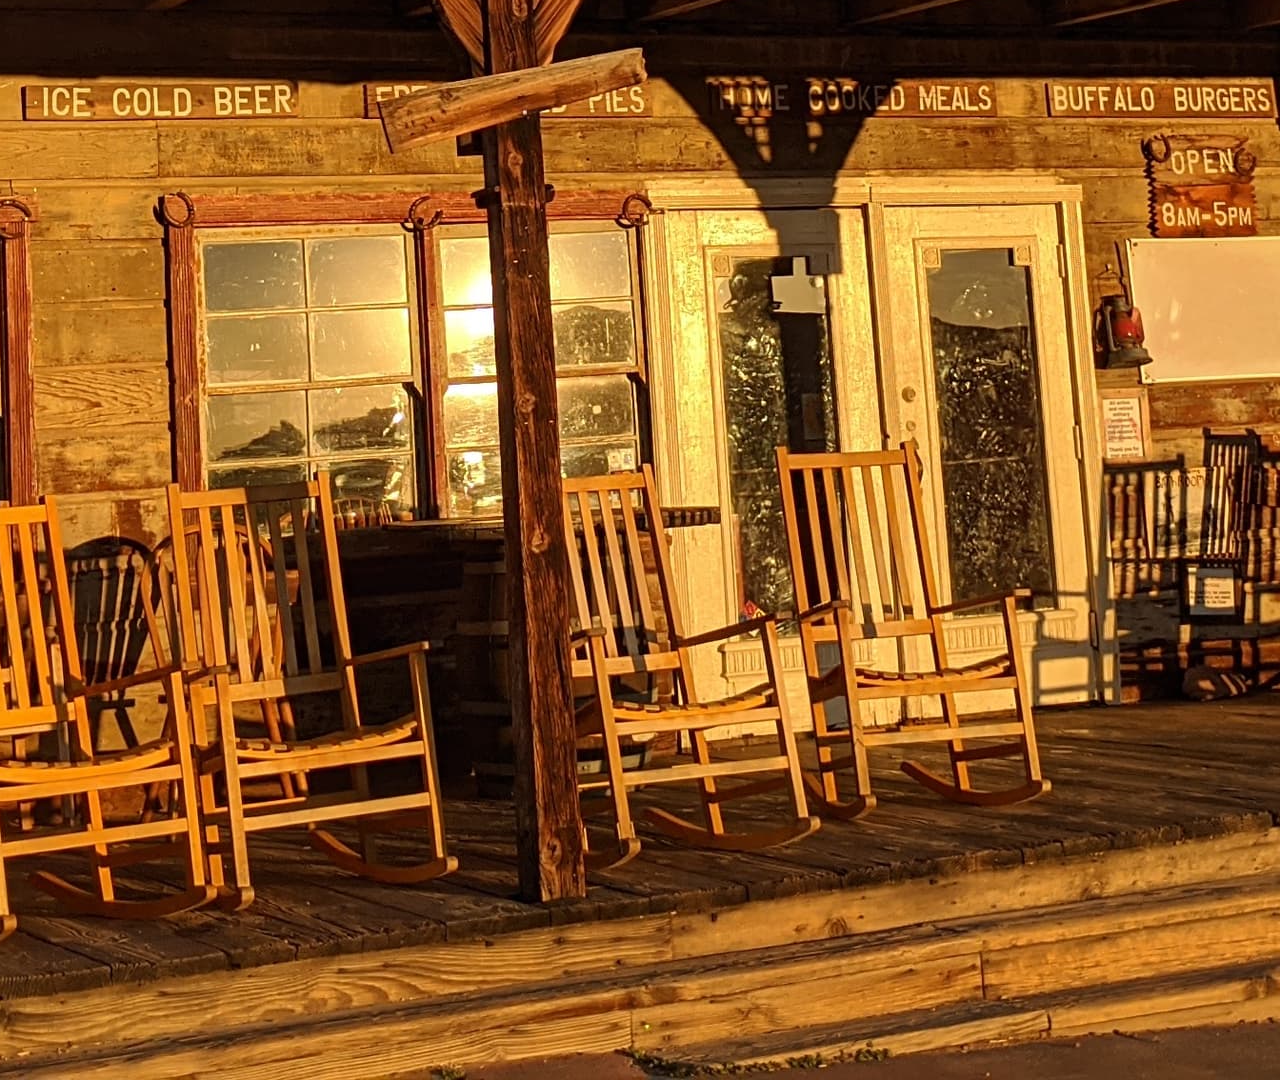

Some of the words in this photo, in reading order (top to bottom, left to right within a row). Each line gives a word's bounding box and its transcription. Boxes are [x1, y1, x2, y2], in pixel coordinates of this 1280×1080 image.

[40, 85, 93, 117] ICE
[111, 86, 193, 117] COLD
[213, 84, 293, 117] BEER
[588, 86, 646, 114] PIES
[719, 83, 792, 112] HOME
[808, 84, 906, 111] COOKED
[919, 84, 993, 112] MEALS
[1052, 86, 1156, 114] BUFFALO
[1175, 86, 1272, 113] BURGERS
[1171, 148, 1234, 175] OPEN
